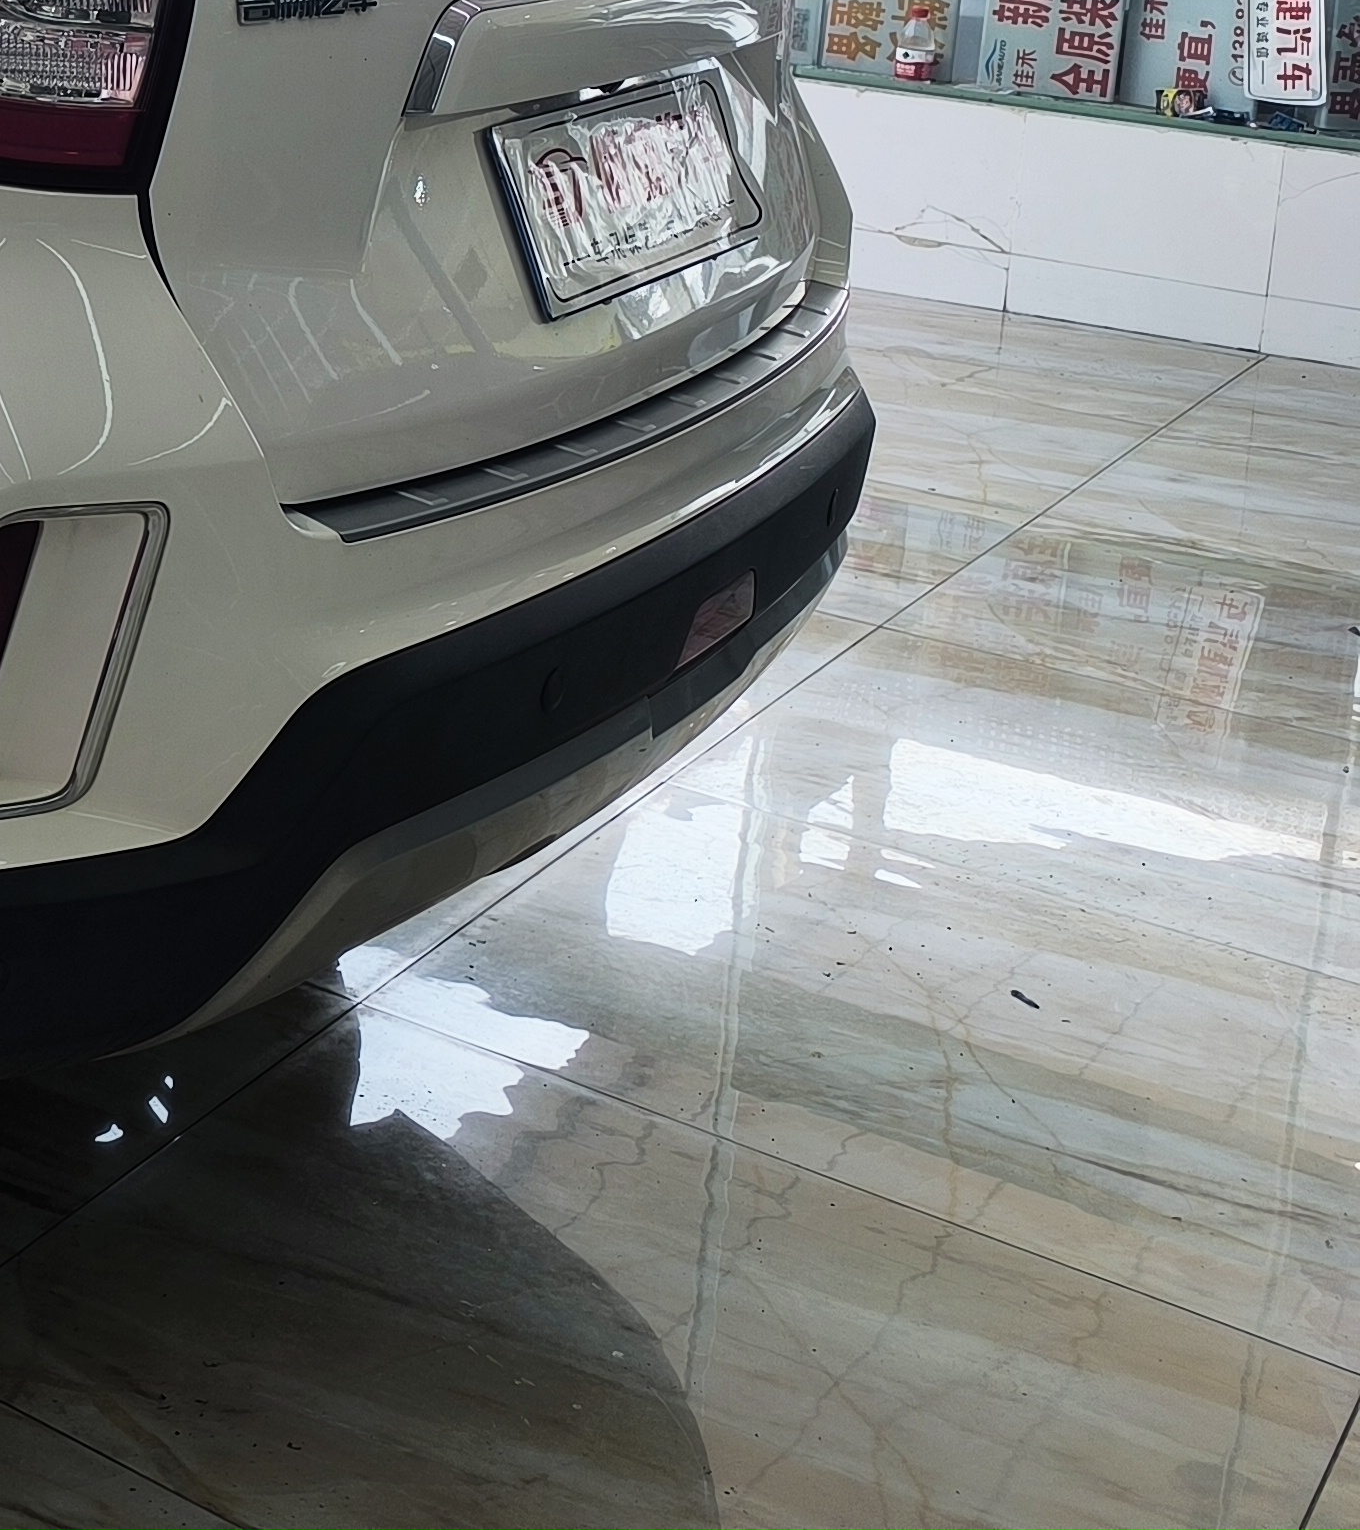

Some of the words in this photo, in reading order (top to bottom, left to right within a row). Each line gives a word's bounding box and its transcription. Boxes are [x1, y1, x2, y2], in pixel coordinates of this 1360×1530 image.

[1255, 2, 1270, 60] 专业诚信
[1011, 48, 1038, 90] 佳禾
